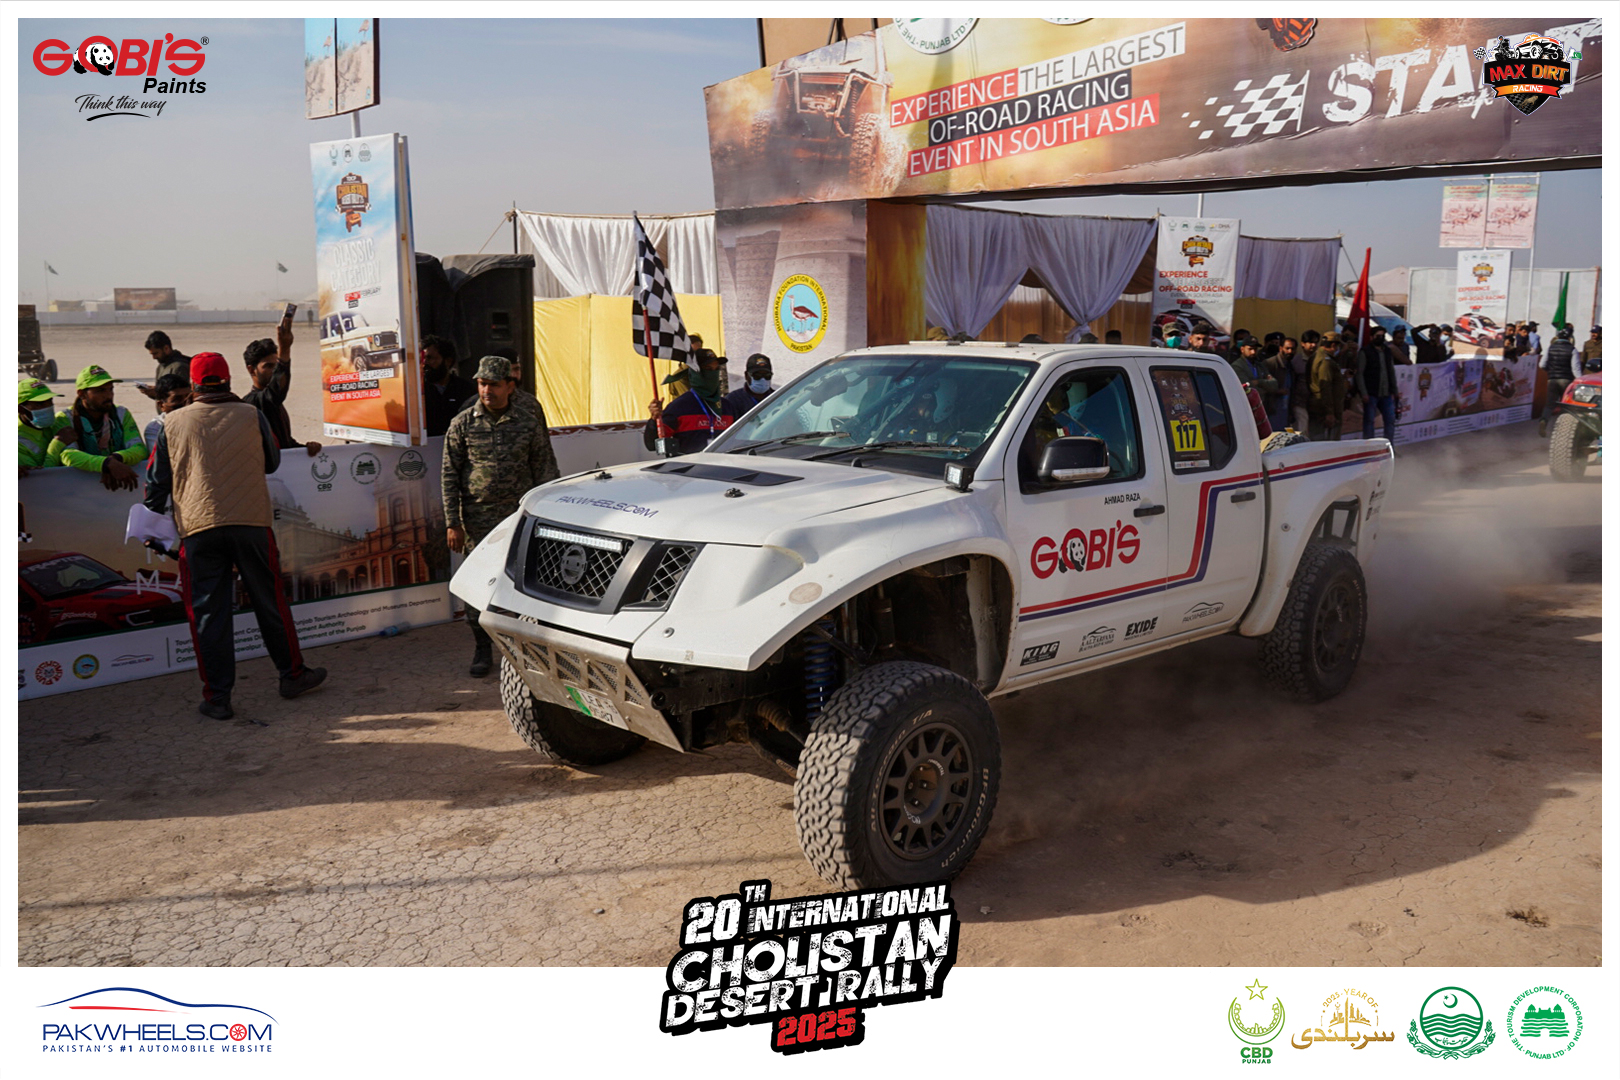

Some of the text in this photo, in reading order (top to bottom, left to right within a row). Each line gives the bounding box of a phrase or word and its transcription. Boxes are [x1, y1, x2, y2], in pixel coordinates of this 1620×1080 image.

[950, 25, 966, 41] LTD
[919, 36, 951, 50] PUNJAB
[891, 26, 1184, 126] EXPERIENCE THE LARGEST
[930, 73, 1129, 144] OF-ROAD RACING
[910, 99, 1156, 175] EVENT IN SOUTH ASIA
[333, 237, 375, 268] CLASSIC
[331, 260, 381, 292] CATEGORY
[1159, 270, 1208, 278] EXPERIENCE
[1158, 285, 1233, 293] OFF-ROAD RACING
[779, 276, 809, 295] FOUNDATION
[809, 278, 828, 331] INTERNATIONAL
[790, 342, 813, 352] PAKISTAN
[330, 368, 393, 382] EXPERIENCE THE LARGEST
[330, 380, 378, 392] OFF-ROAD RACING
[331, 389, 381, 401] EVENT IN SOUTH ASIA
[1175, 424, 1197, 448] 117
[555, 495, 660, 518] PAKWHEELS.COM
[1104, 493, 1141, 506] AHMAD RAZA
[1030, 519, 1141, 580] GOBI'S
[314, 615, 336, 623] Tourism
[337, 609, 369, 619] Archeology
[382, 603, 408, 611] Museums
[408, 597, 442, 608] Department
[318, 620, 345, 630] Authority
[346, 624, 366, 633] Punjab
[1125, 617, 1159, 637] EXIDE
[1023, 641, 1058, 659] KING
[912, 709, 933, 725] T/A
